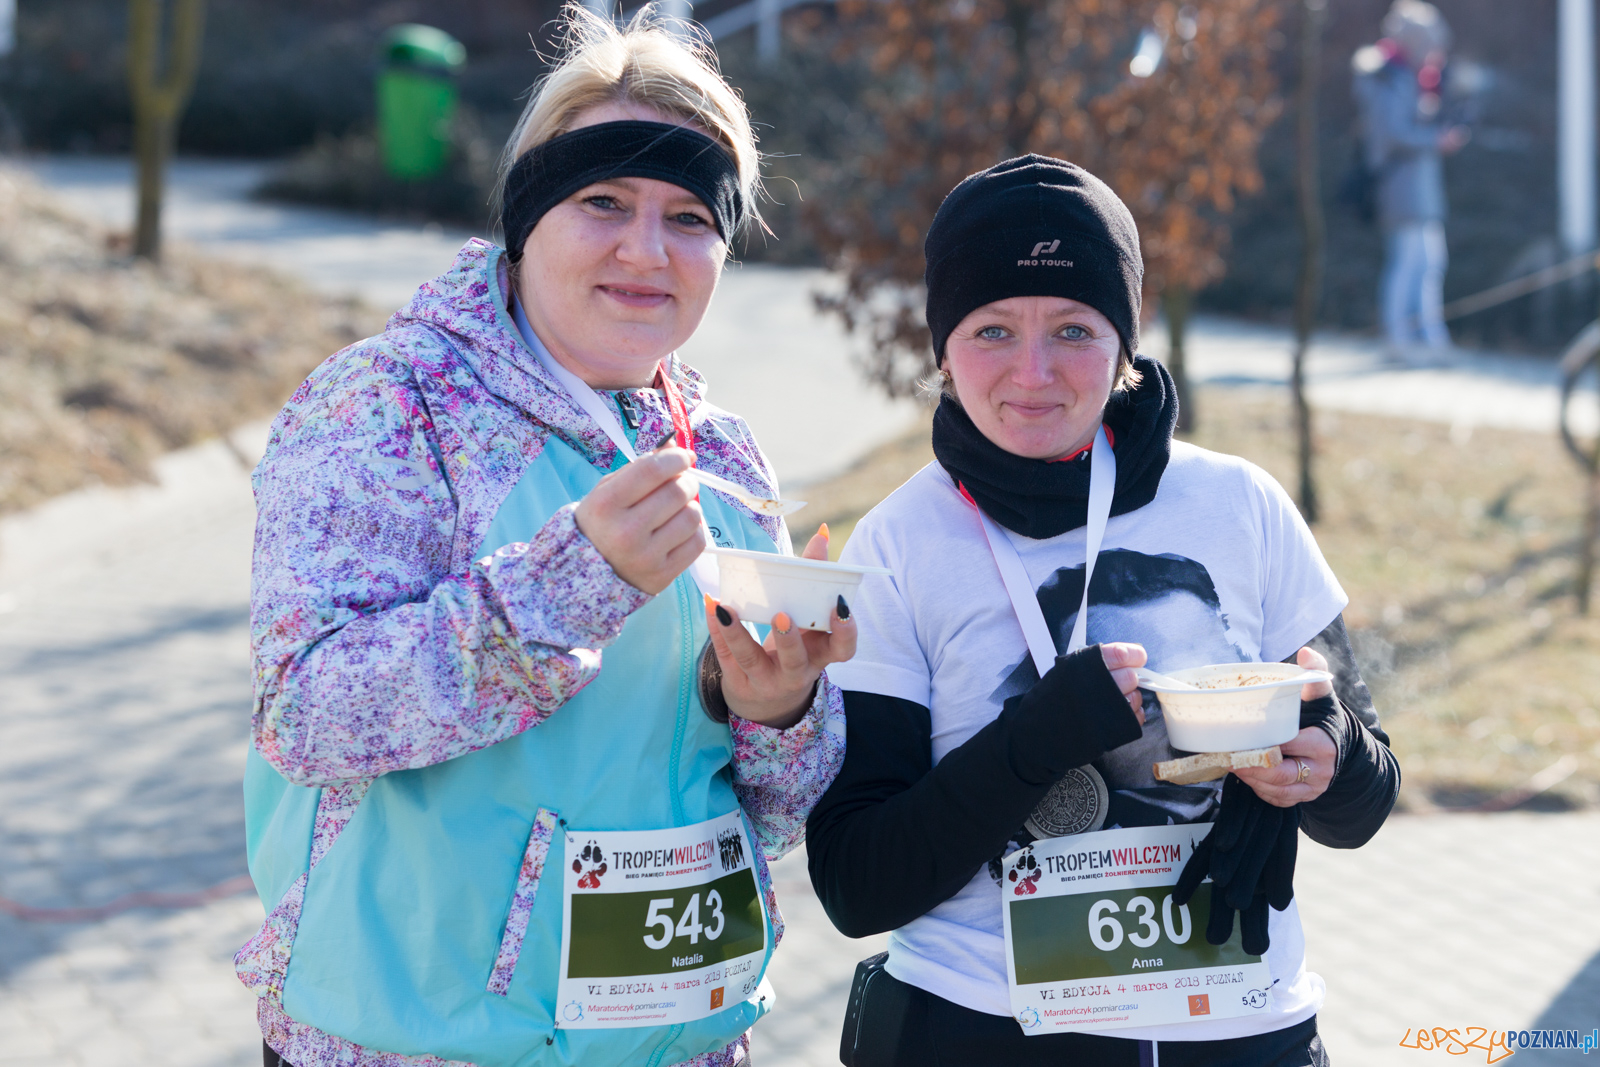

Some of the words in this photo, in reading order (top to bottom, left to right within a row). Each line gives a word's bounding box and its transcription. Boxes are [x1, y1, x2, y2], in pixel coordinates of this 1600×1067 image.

[1017, 259, 1038, 267] PRO
[1041, 259, 1074, 268] TOUCH
[1060, 875, 1077, 883] BIEG
[1077, 873, 1104, 881] PAMIĘCI
[1104, 869, 1139, 878] ŻOŁNIERZY
[1139, 867, 1172, 876] WYKLĘTYCH
[643, 888, 725, 950] 543
[1088, 894, 1192, 951] 630
[671, 953, 704, 968] Natalia
[1131, 957, 1164, 970] Anna
[587, 985, 602, 995] VI
[608, 982, 655, 995] EDYCJA
[660, 981, 669, 991] 4
[673, 979, 701, 990] marca
[704, 971, 721, 985] 2018
[1040, 989, 1055, 1000] VI
[1062, 983, 1111, 999] EDYCJA
[1117, 983, 1127, 994] 4
[1133, 982, 1169, 993] marca
[1174, 976, 1200, 989] 2018
[1205, 971, 1244, 986] POZNAŃ
[1242, 995, 1257, 1006] 5,4
